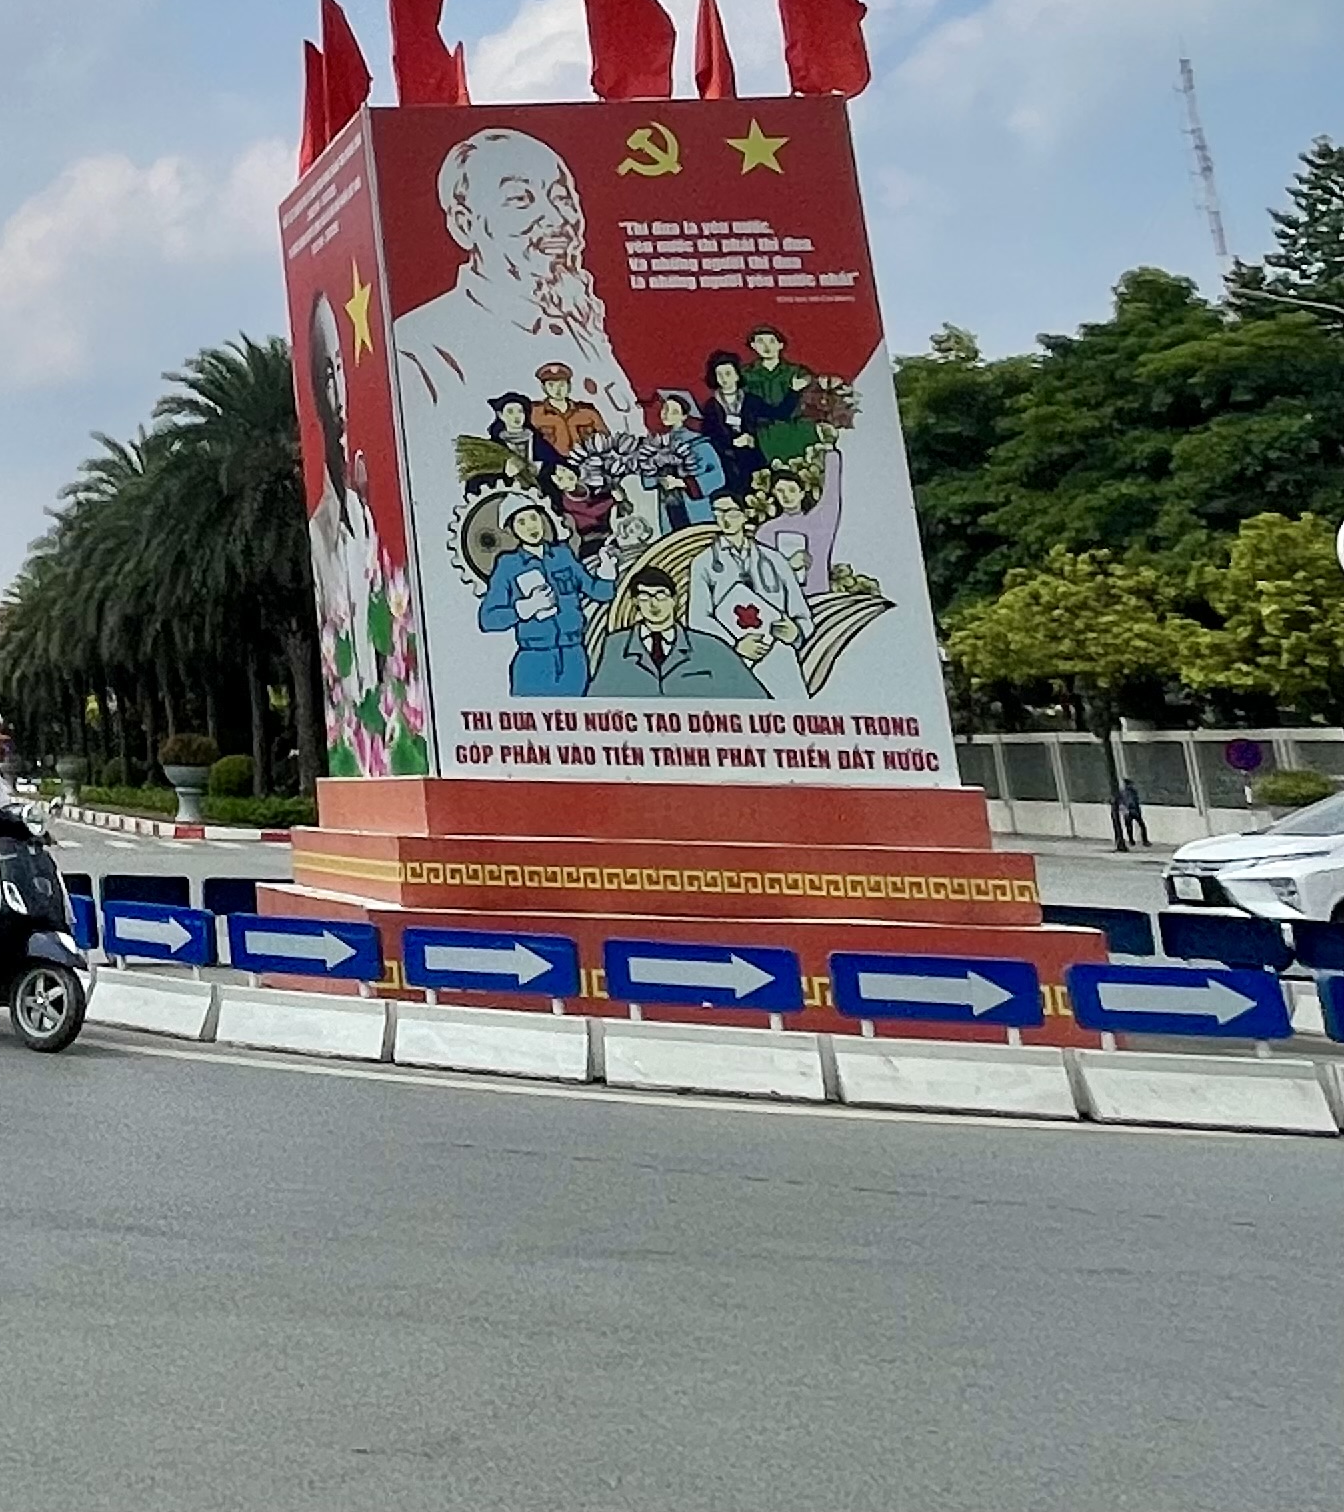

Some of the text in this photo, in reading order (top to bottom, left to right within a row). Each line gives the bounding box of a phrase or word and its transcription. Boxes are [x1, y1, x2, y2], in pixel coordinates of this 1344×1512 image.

[460, 709, 921, 741] THI ĐUA YÊU NƯỚC TẠO ĐỘNG LỰC QUAN TRỌNG
[455, 738, 941, 772] GÓP PHẦN VÀO TIẾN TRÌNH PHÁT TRIỂN ĐẤT NƯỚC
